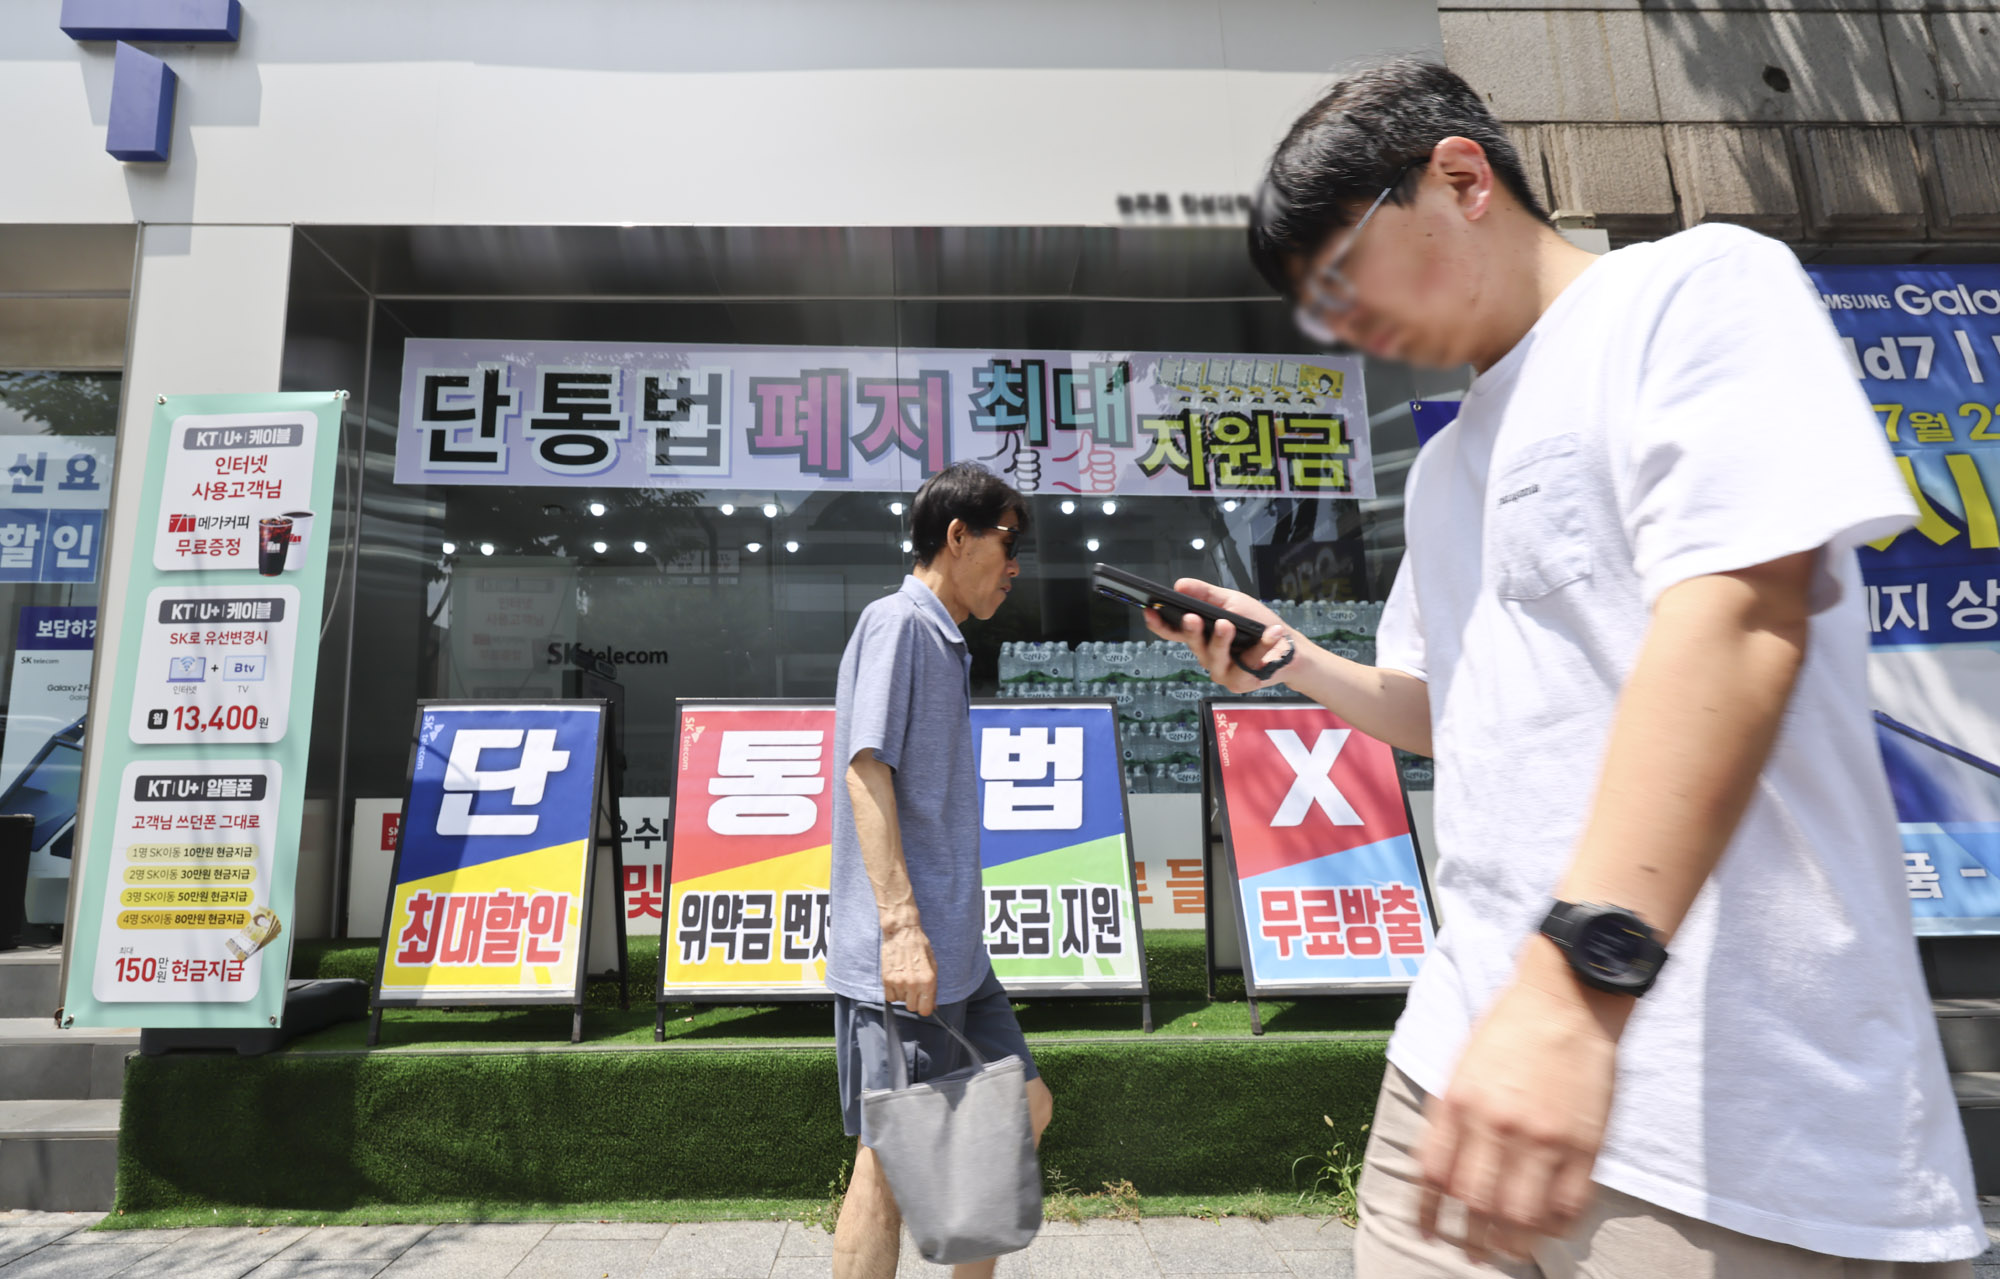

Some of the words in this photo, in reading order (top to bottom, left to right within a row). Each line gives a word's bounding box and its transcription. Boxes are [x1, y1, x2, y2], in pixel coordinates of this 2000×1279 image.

[1823, 294, 1892, 309] MSUNG
[416, 362, 731, 475] 단통법
[746, 368, 952, 479] 폐지
[969, 359, 1134, 447] 최대
[1872, 403, 1954, 443] 7월
[196, 431, 217, 447] KT
[224, 430, 242, 446] U+
[248, 428, 291, 445] 케이블
[1136, 409, 1355, 492] 지원금
[215, 455, 268, 475] 인터넷
[192, 480, 282, 501] 사용고객님
[198, 515, 250, 530] 메가커피
[0, 523, 93, 568] 할인
[176, 538, 241, 557] 무료증정
[171, 604, 193, 620] KT
[200, 603, 220, 619] U+
[226, 602, 271, 619] 케이블
[170, 632, 200, 645] SK로
[204, 631, 267, 645] 유선변경시
[47, 684, 77, 692] Galaxy
[173, 686, 197, 695] 인터넷
[237, 685, 249, 694] TV
[423, 715, 435, 730] SK
[685, 716, 695, 732] SK
[1216, 713, 1228, 728] SK
[682, 735, 692, 770] telecom
[1219, 732, 1230, 767] telecom
[436, 729, 571, 835] 단
[707, 730, 825, 835] 통
[980, 727, 1083, 830] 법
[1264, 729, 1365, 826] X
[148, 780, 171, 797] KT
[178, 780, 199, 798] U+
[206, 779, 252, 797] 알뜰폰
[132, 815, 172, 830] 고객님
[176, 815, 216, 830] 쓰던폰
[219, 815, 260, 830] 그대로
[133, 847, 148, 858] 1명
[150, 847, 181, 858] SK이동
[184, 847, 214, 858] 10만원
[216, 847, 253, 858] 현금지급
[129, 869, 144, 880] 2명
[146, 869, 178, 880] SK이동
[181, 869, 212, 880] 30만원
[213, 869, 250, 880] 현금지급
[126, 891, 142, 902] 3명
[144, 891, 175, 902] SK이동
[178, 891, 208, 902] 50만원
[210, 891, 248, 902] 현금지급
[123, 914, 139, 925] 4명
[140, 914, 172, 925] SK이동
[175, 914, 206, 925] 80만원
[208, 914, 245, 925] 현금지급
[396, 889, 569, 966] 최대할인
[678, 892, 773, 961] 위약금
[983, 887, 1050, 955] 조금
[1061, 886, 1122, 954] 지원
[1260, 884, 1425, 957] 무료방출
[119, 947, 134, 955] 최대
[172, 959, 245, 983] 현금지급
